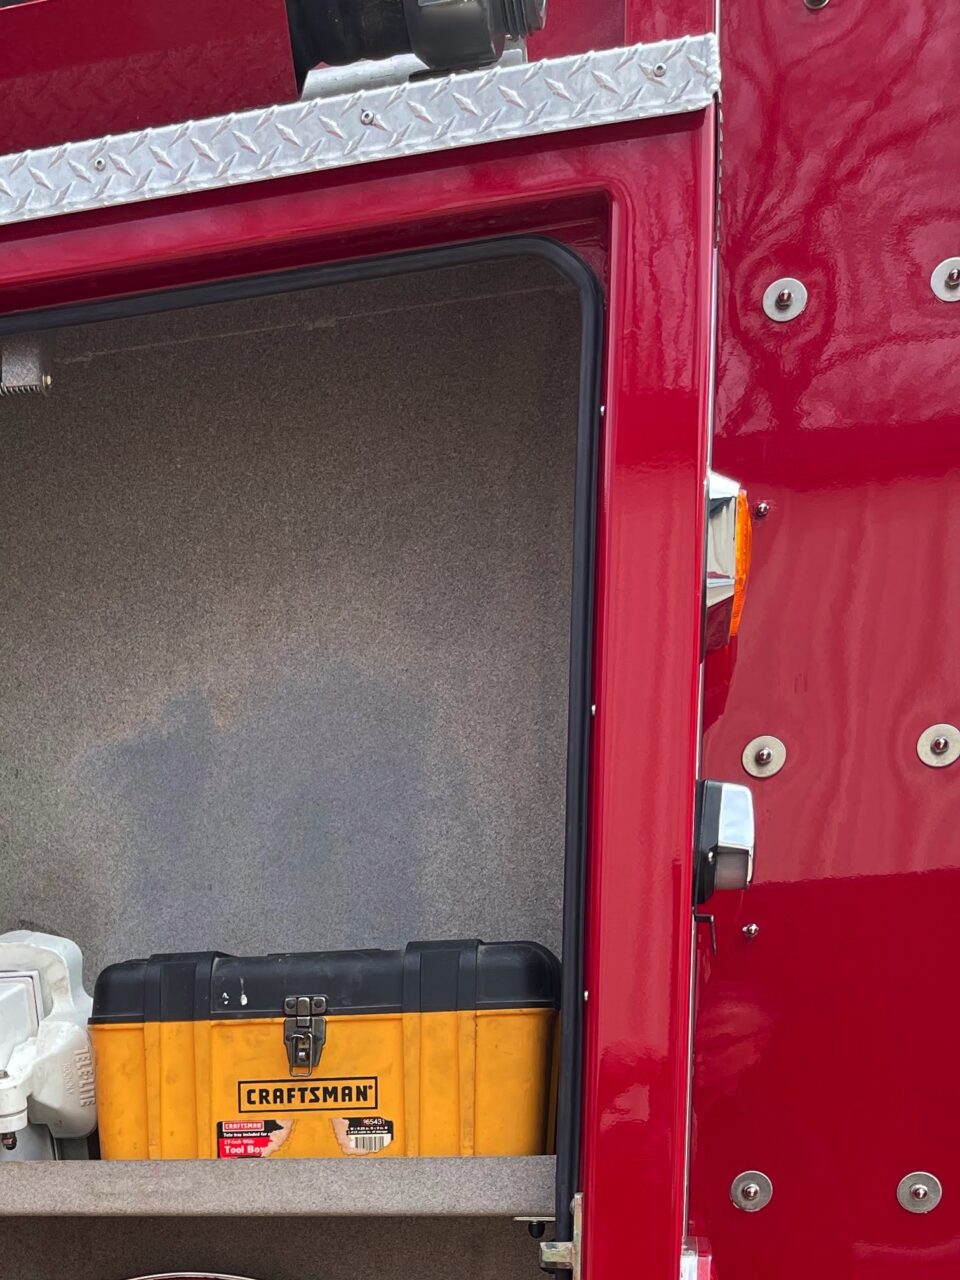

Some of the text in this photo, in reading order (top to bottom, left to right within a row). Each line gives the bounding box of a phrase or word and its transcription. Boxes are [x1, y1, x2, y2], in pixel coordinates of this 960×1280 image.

[73, 1046, 97, 1107] TELE-LITE
[246, 1085, 369, 1105] CRAFTSMAN
[224, 1122, 262, 1130] CRAFTSMAN
[224, 1145, 244, 1154] Tool
